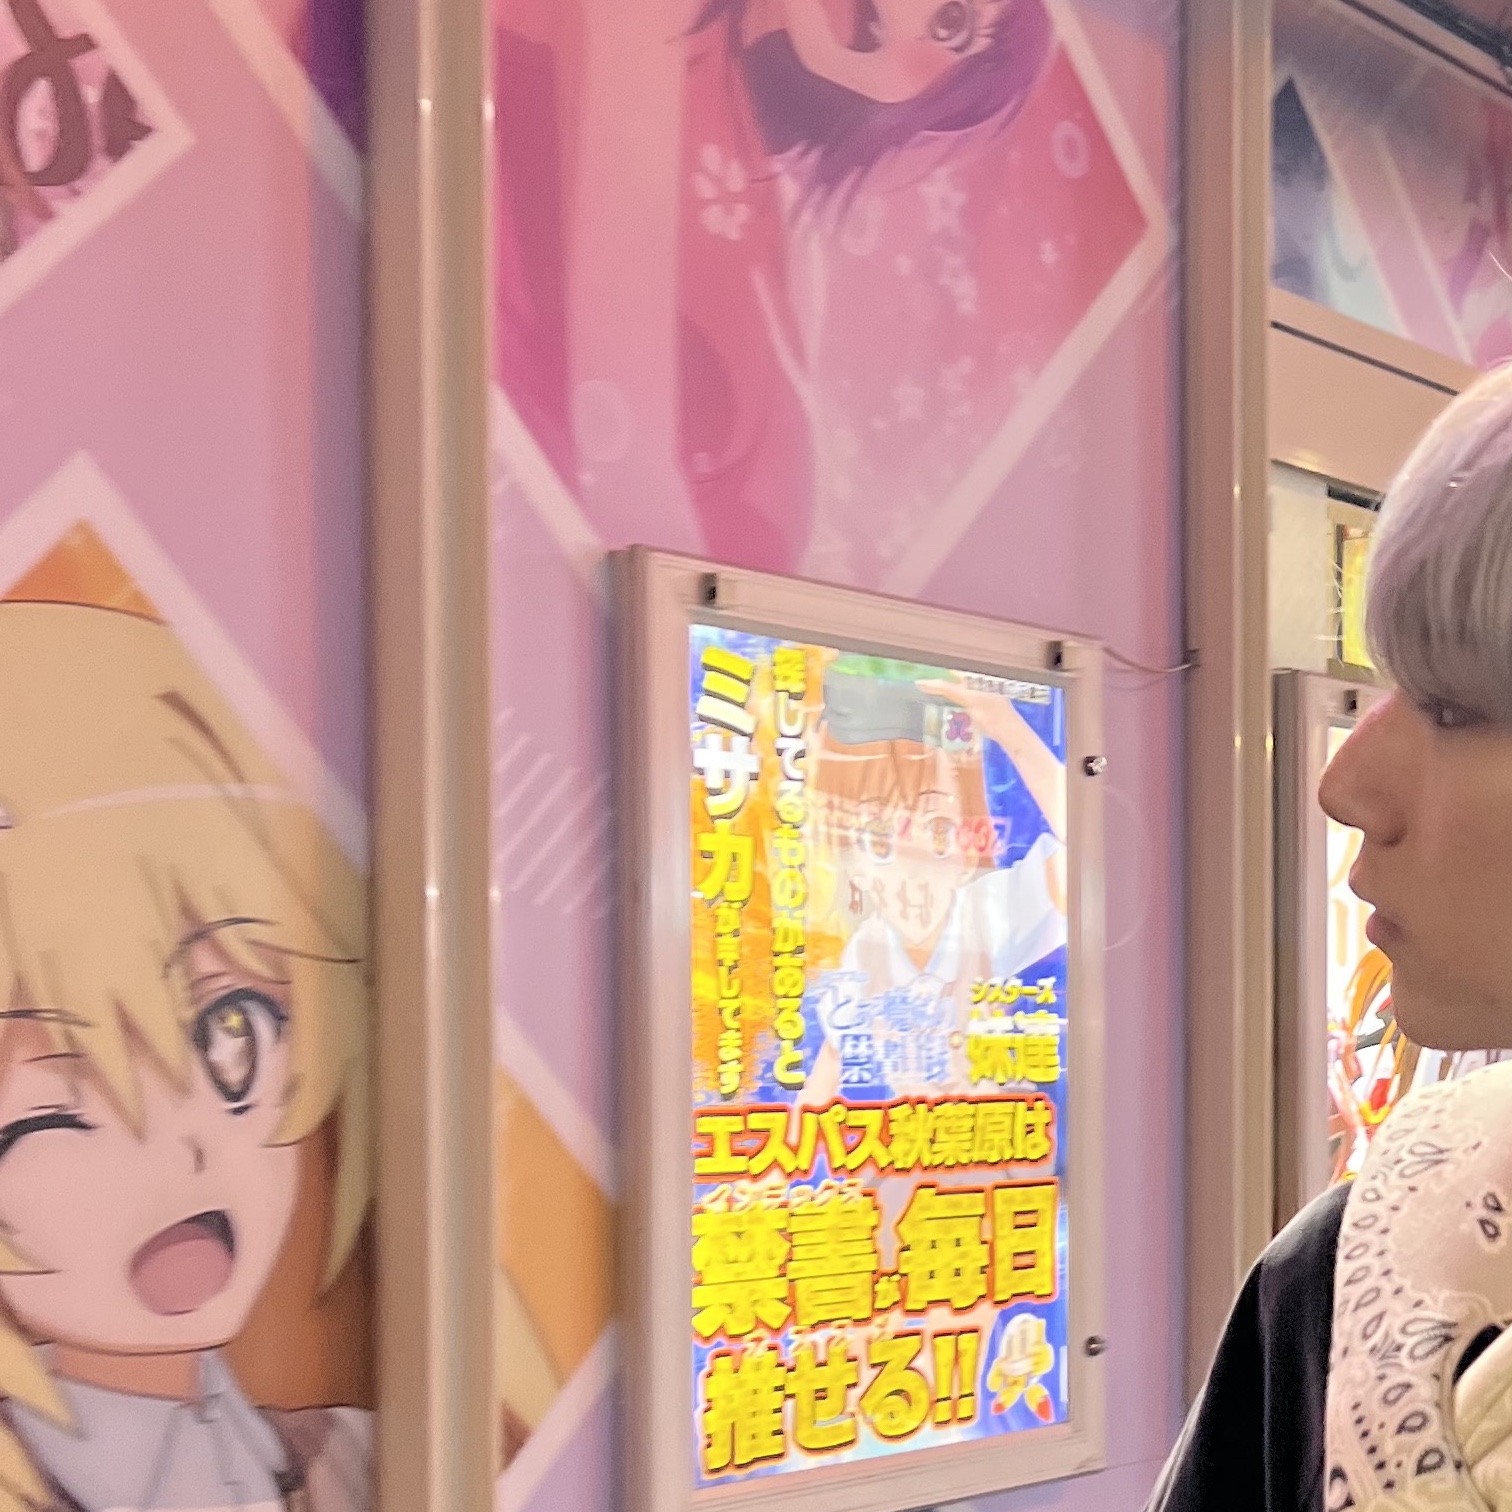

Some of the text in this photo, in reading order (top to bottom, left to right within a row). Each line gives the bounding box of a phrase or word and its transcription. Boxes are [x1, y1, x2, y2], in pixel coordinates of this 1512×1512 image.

[969, 976, 1058, 1006] シスターズ
[966, 1010, 1060, 1088] 妹達
[694, 1099, 1052, 1176] エスパス秋葉原は
[691, 1184, 1058, 1338] 禁書が毎日
[703, 1330, 981, 1472] 推せる!!
